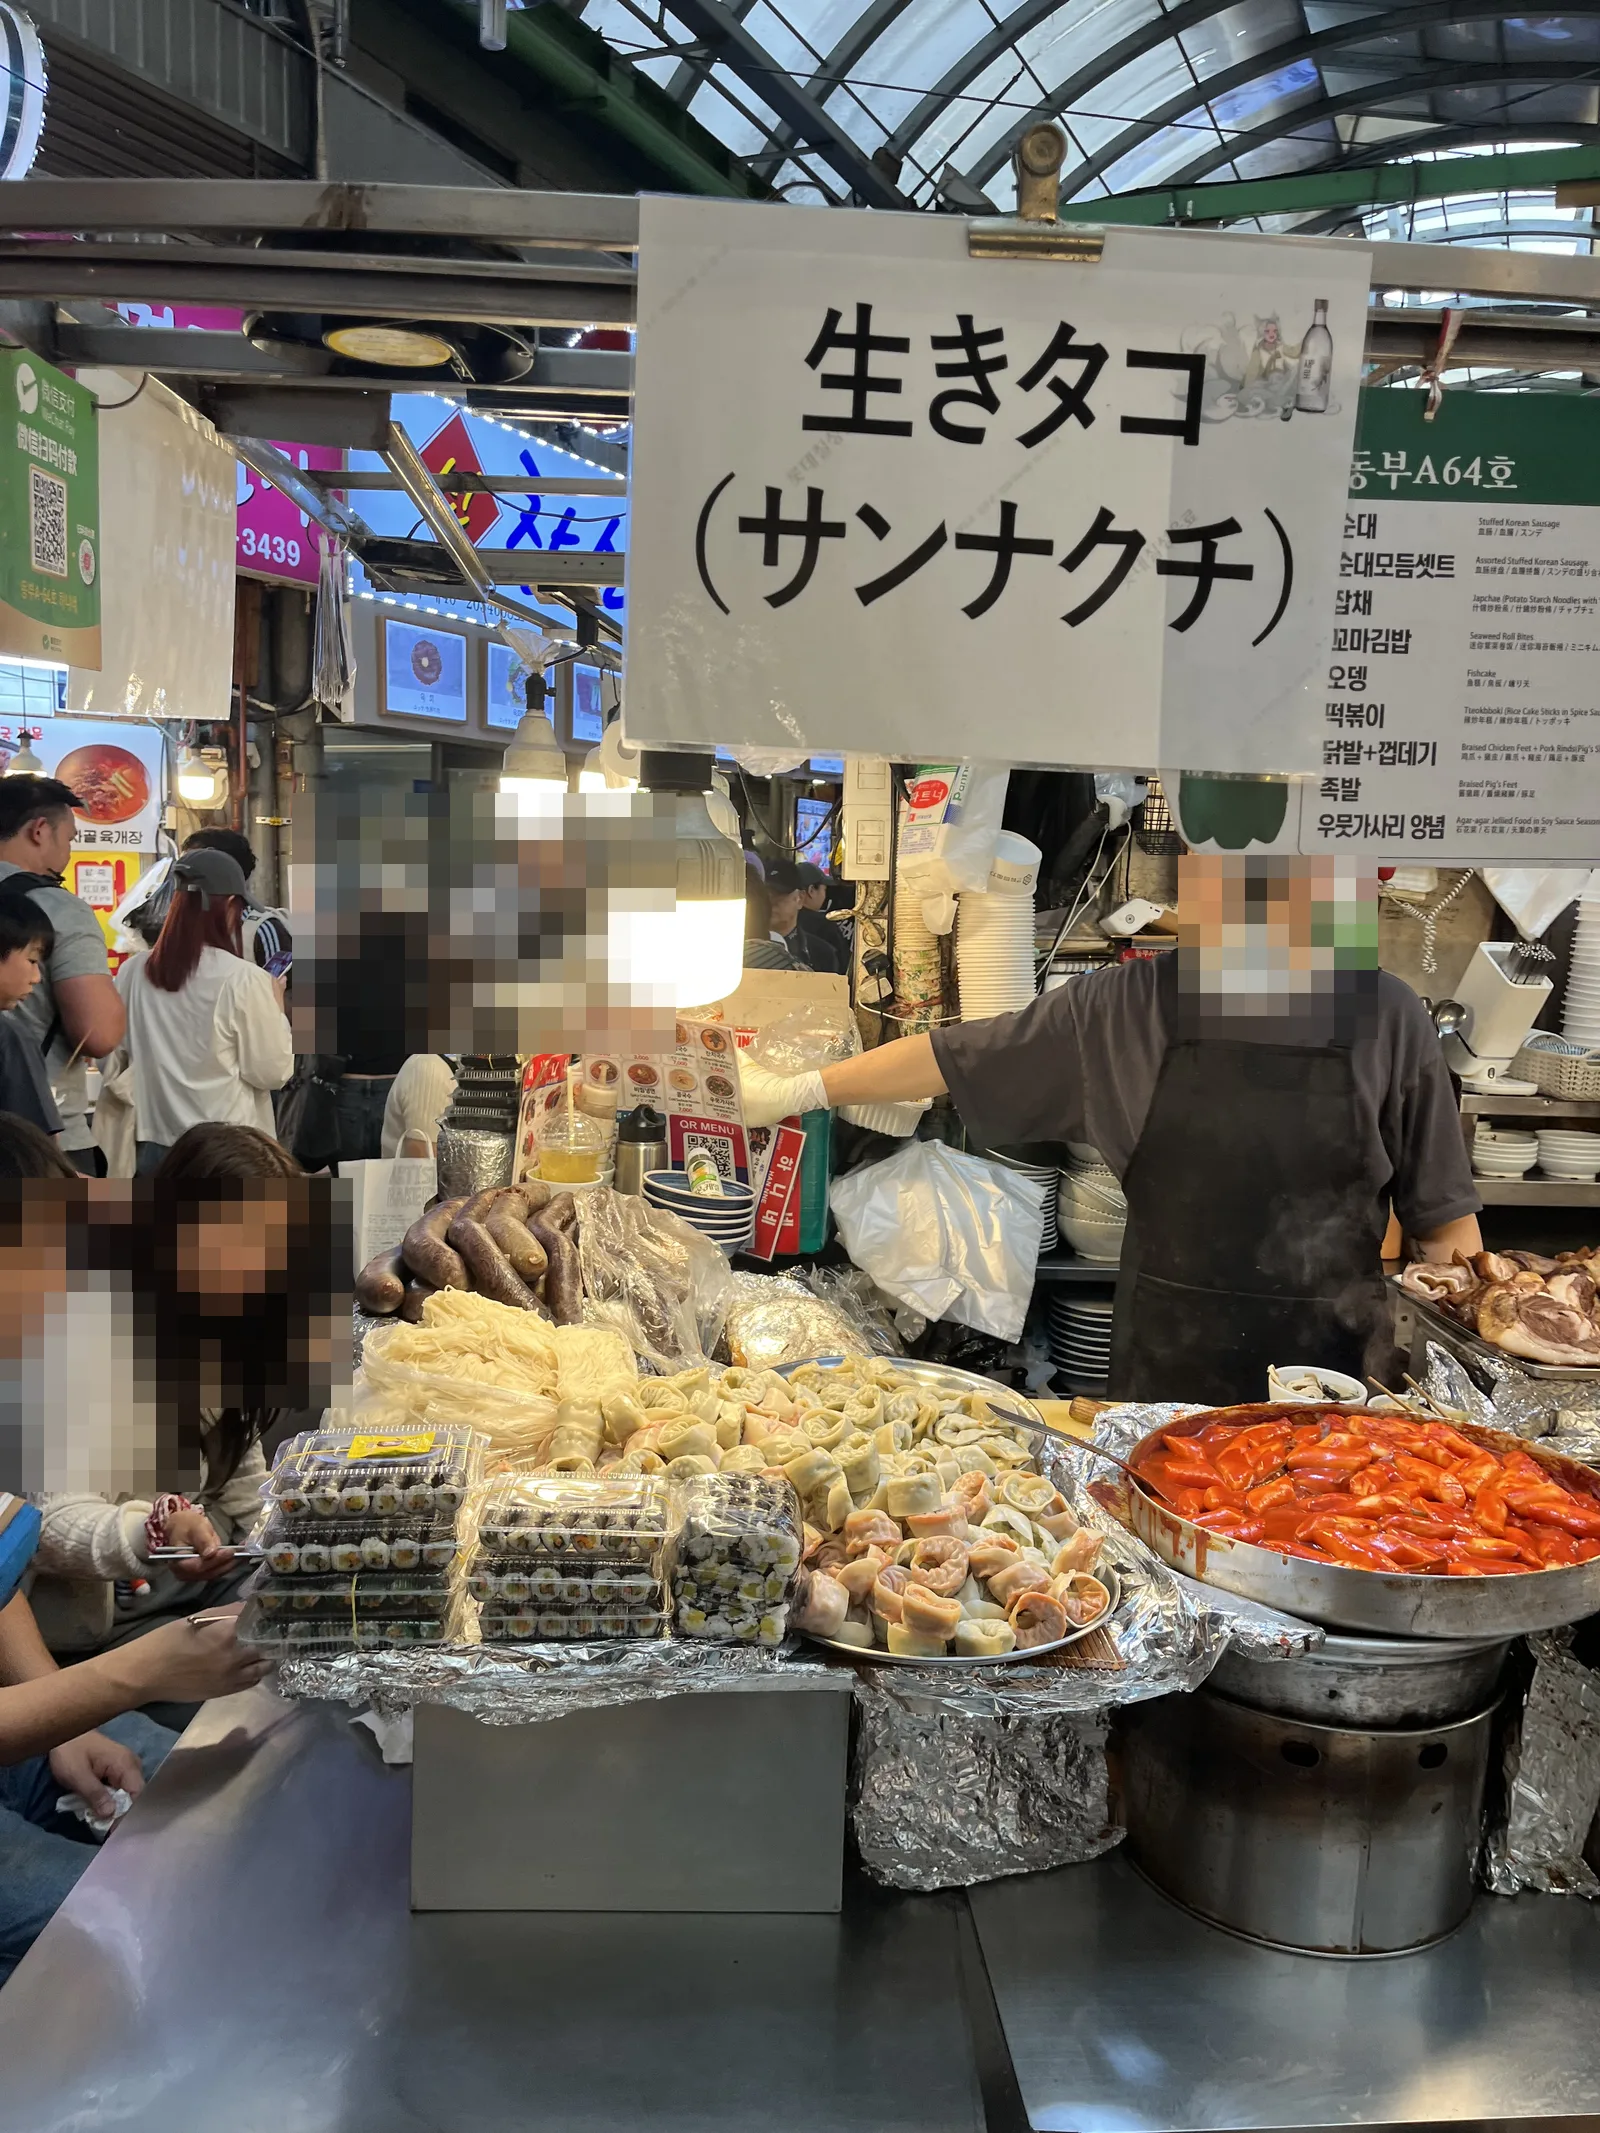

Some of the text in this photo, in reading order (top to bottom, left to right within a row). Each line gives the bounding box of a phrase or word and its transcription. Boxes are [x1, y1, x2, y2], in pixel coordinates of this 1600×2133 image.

[802, 302, 1207, 448] 生きタコ
[1478, 517, 1560, 530] Stuffed Korean Sausage
[1475, 556, 1589, 569] Assorted Stuffed Korean Sausage
[1472, 594, 1501, 604] Japchae
[1529, 595, 1551, 604] Starch
[1552, 596, 1581, 605] Noodles
[1582, 596, 1598, 605] with
[1470, 631, 1534, 641] Seaweed Roll Bites
[1327, 665, 1368, 692] 오뎅
[1467, 669, 1496, 678] Fishcake
[1325, 703, 1385, 729] 떡볶이
[1522, 707, 1539, 716] Cake
[1540, 708, 1560, 716] Sticks
[1461, 743, 1487, 752] Braised
[1488, 744, 1515, 752] Chicken
[1516, 744, 1532, 752] Feet
[1539, 744, 1555, 752] Pork
[1320, 777, 1362, 802] 족발
[1458, 780, 1484, 788] Braised
[1485, 780, 1501, 791] Pig's
[1410, 814, 1446, 840] 양념
[1456, 816, 1490, 826] Agar-agar
[1515, 817, 1533, 825] Food
[1541, 817, 1553, 827] Soy
[1555, 817, 1575, 825] Sauce
[100, 830, 143, 845] 육개장
[679, 1119, 735, 1136] QR MENU
